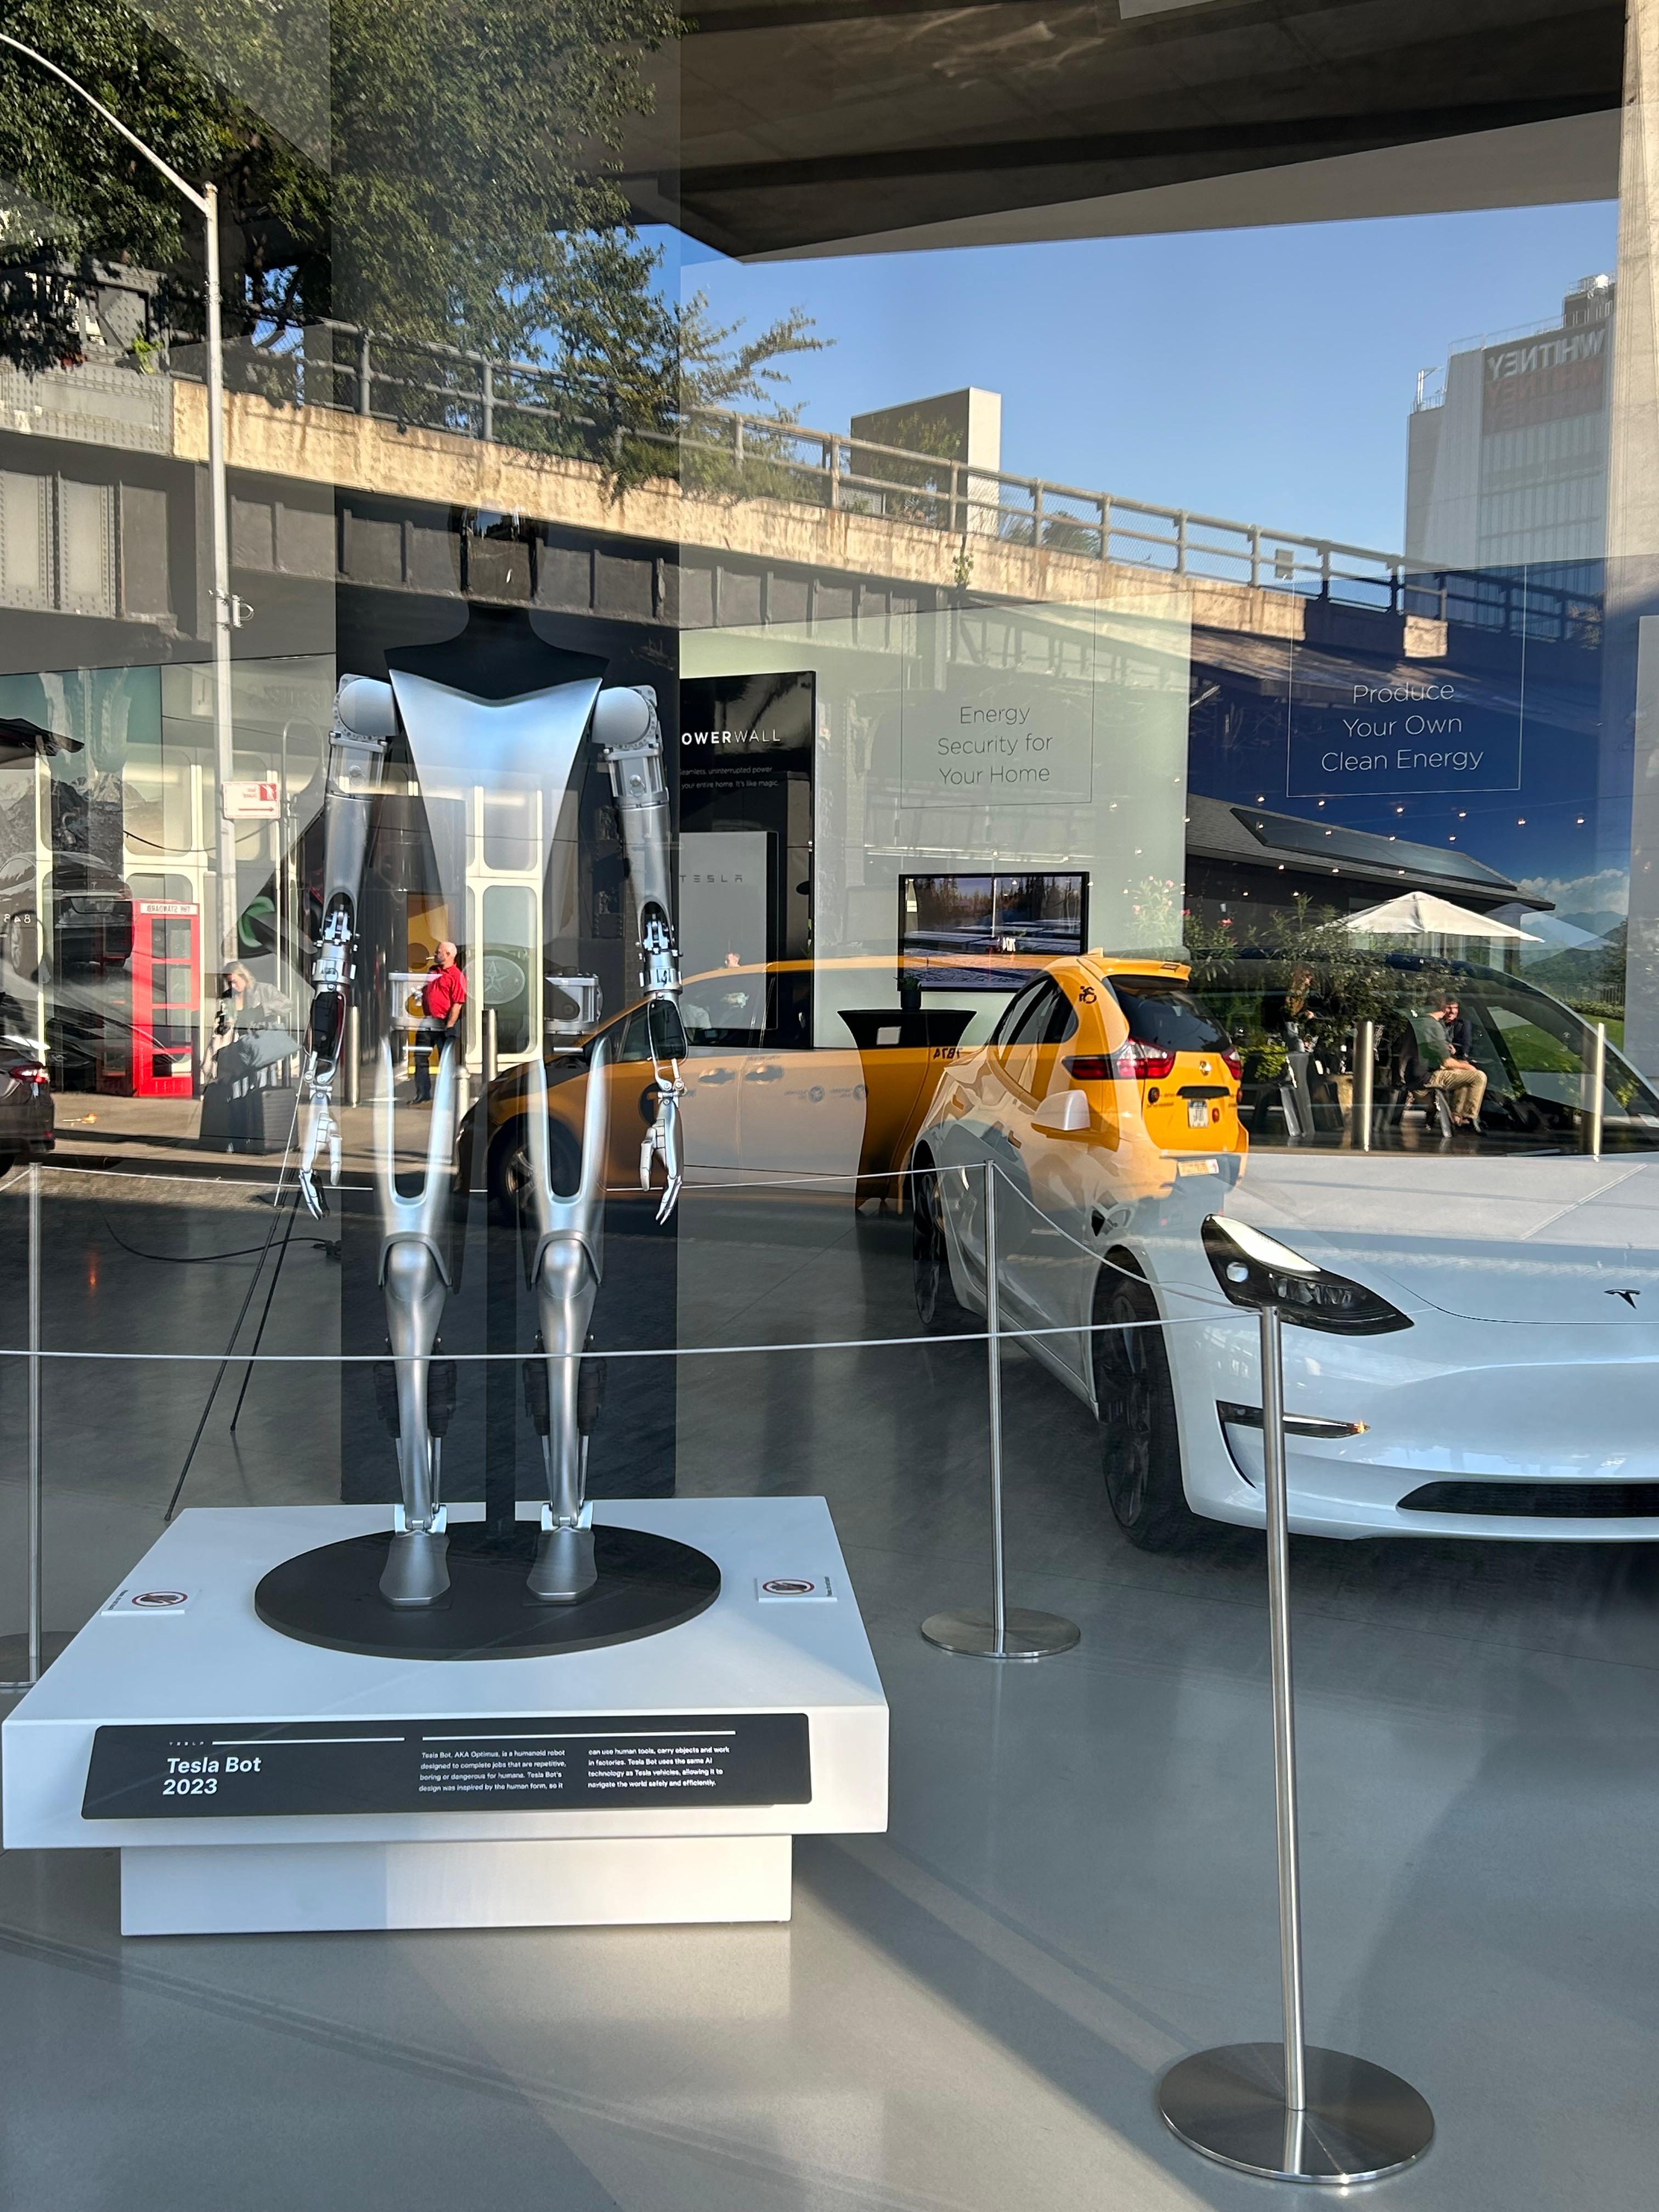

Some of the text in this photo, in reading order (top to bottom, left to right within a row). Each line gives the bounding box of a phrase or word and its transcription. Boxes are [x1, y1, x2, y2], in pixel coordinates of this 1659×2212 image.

[1353, 682, 1454, 704] Produce
[960, 706, 1030, 725] Energy
[1343, 715, 1462, 738] Your Own
[681, 729, 781, 745] OWERWALL
[938, 733, 1053, 756] Security for
[1321, 749, 1483, 772] Clean Energy
[708, 766, 751, 775] uninterrupted
[940, 765, 1050, 786] Your Home
[680, 874, 743, 883] TESLA
[167, 1756, 262, 1774] Tesla Bot
[163, 1778, 218, 1795] 2023
